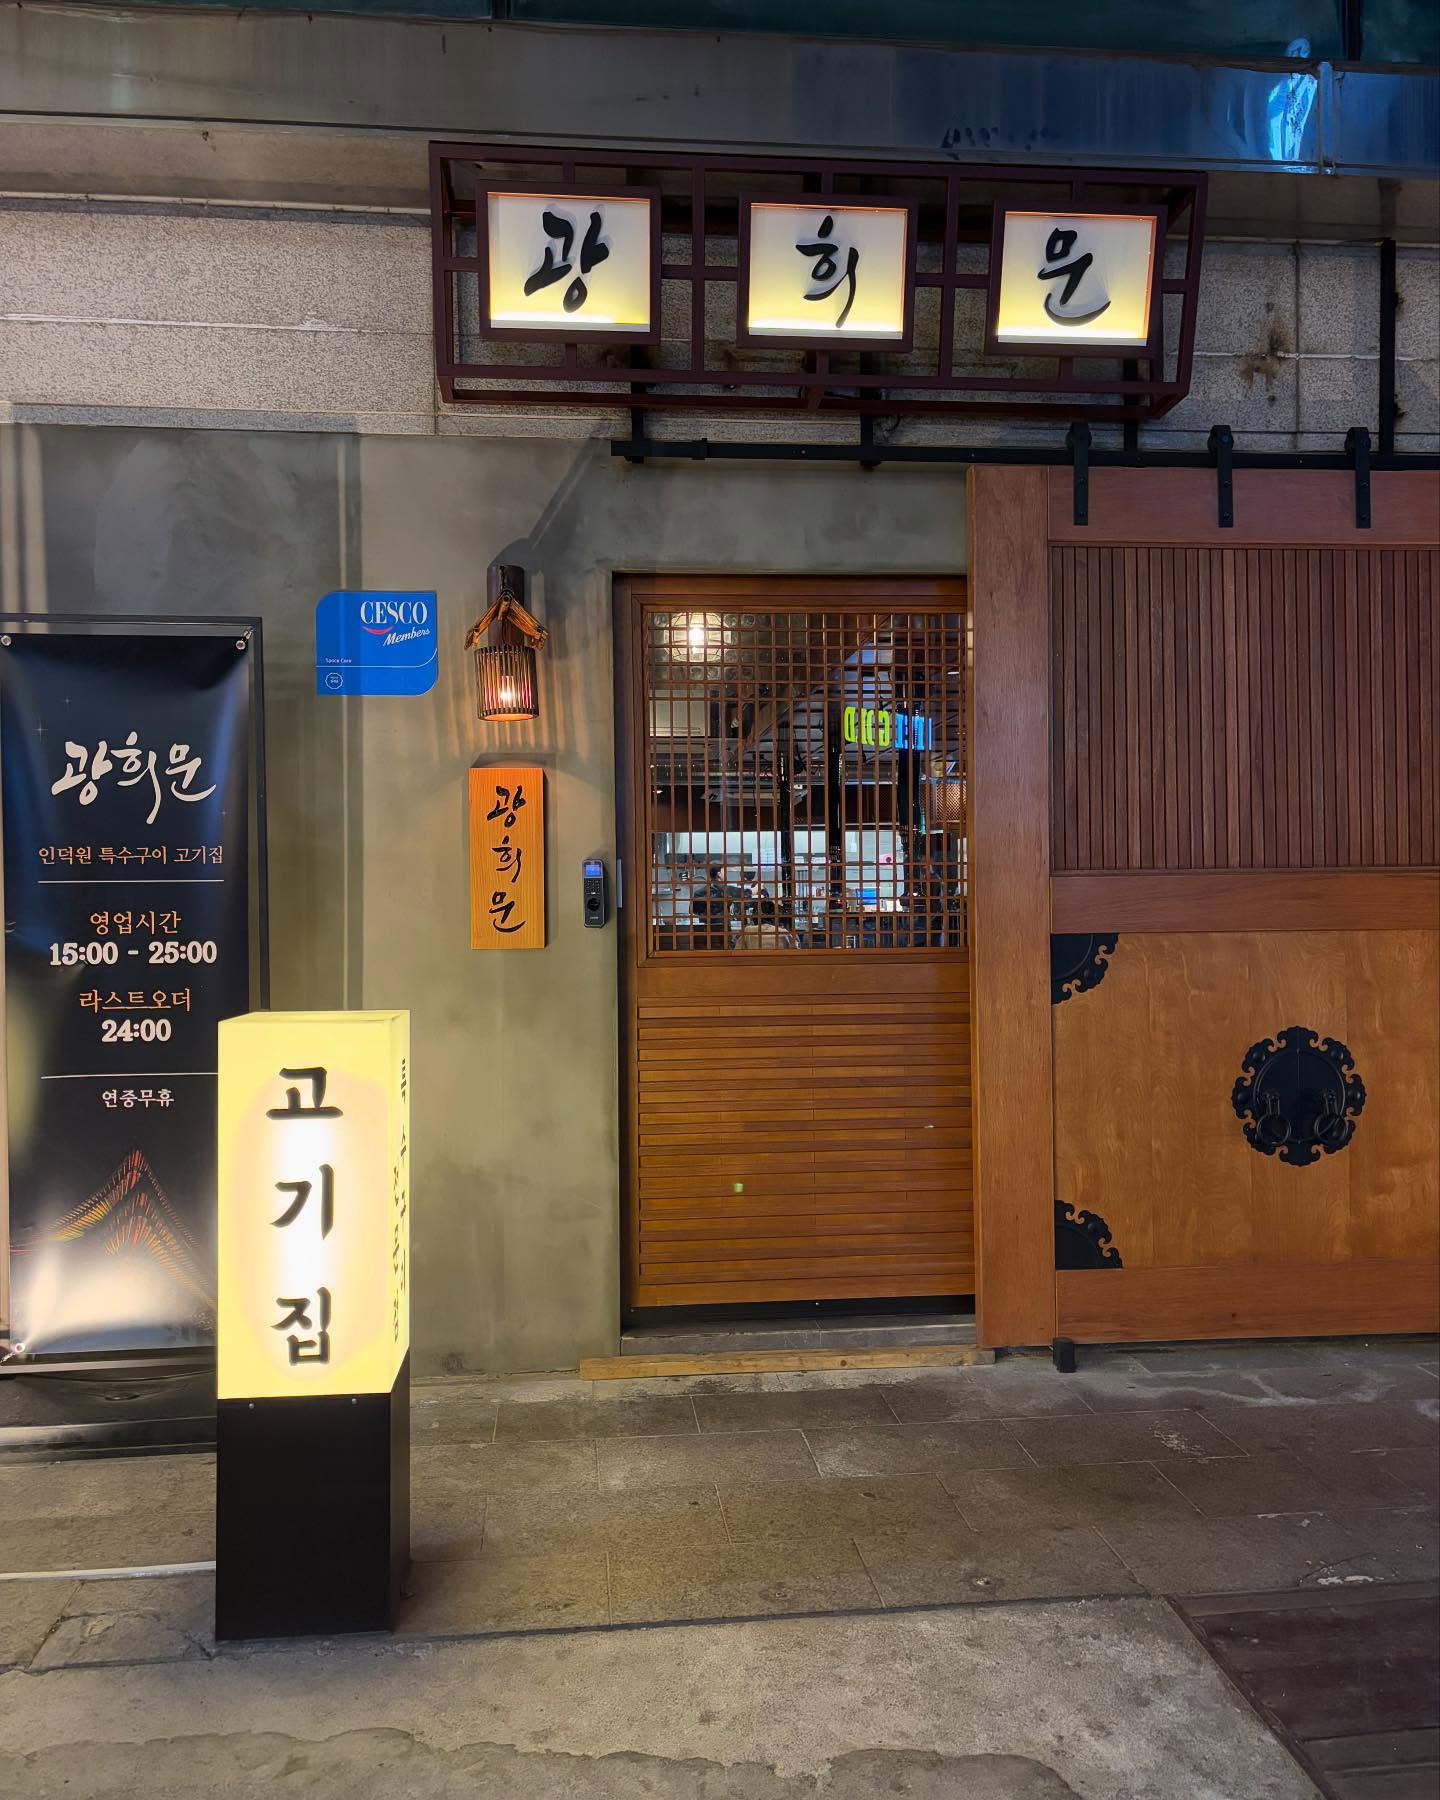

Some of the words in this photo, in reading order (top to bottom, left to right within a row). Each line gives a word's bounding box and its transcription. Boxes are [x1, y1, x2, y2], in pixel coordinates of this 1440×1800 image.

[524, 210, 1112, 328] 광희문
[360, 601, 428, 625] CESCO
[383, 626, 431, 647] Members
[51, 731, 217, 825] 광희문
[38, 846, 92, 865] 인덕원
[98, 846, 167, 865] 특수구이
[173, 845, 223, 865] 고기집
[486, 785, 527, 933] 광희문
[90, 911, 182, 936] 영업시간
[50, 941, 119, 966] 15:00
[148, 941, 218, 964] 25:00
[101, 1019, 172, 1042] 24:00
[102, 1088, 175, 1108] 연중무휴
[265, 1066, 344, 1366] 고기집
